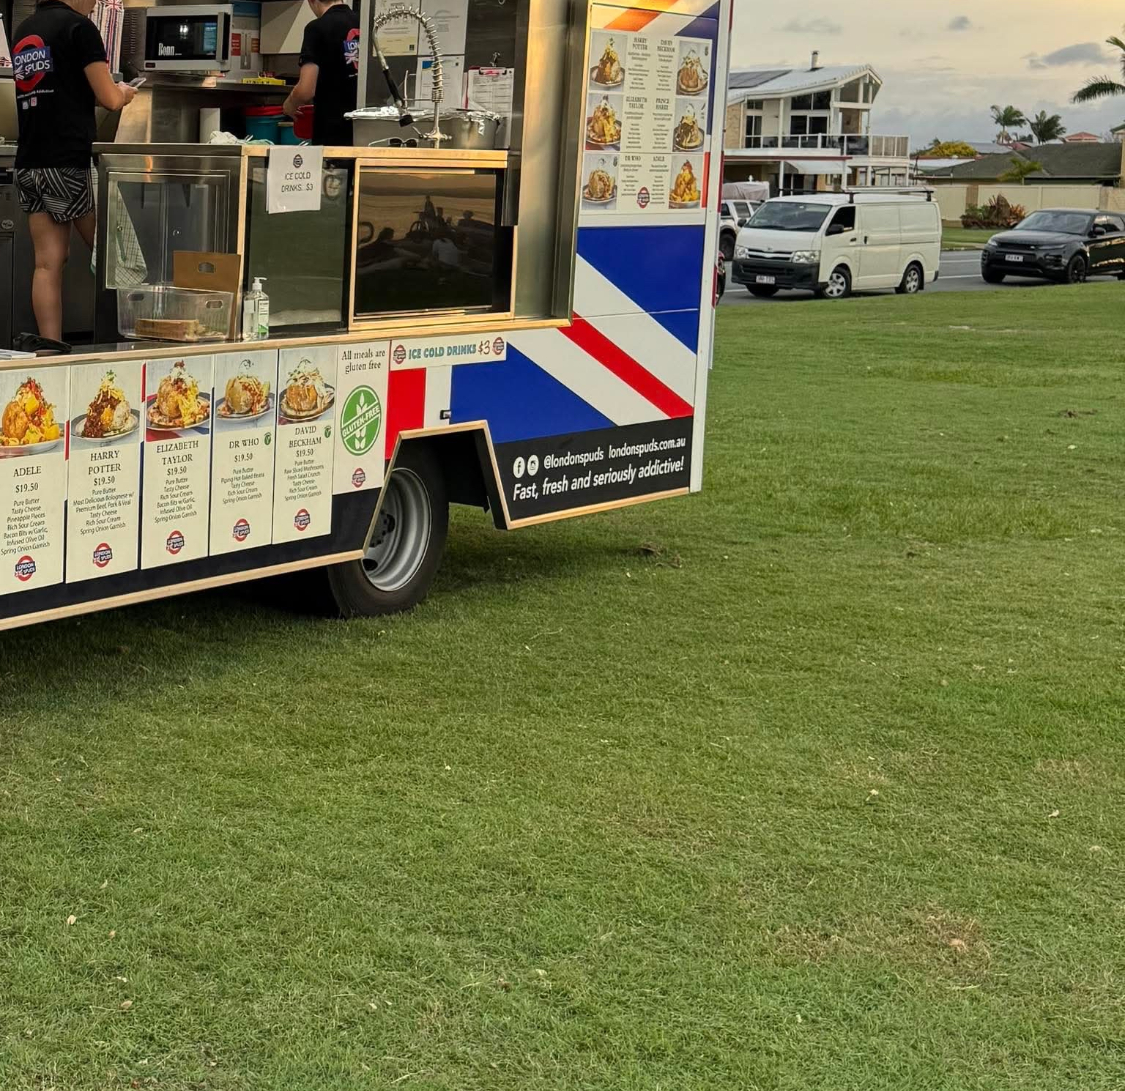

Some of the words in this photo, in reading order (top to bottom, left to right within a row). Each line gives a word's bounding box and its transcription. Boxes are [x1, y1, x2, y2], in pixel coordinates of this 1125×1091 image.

[15, 50, 45, 65] ONDON
[342, 350, 351, 360] All
[354, 349, 374, 359] meals
[409, 349, 421, 359] ICE
[424, 347, 444, 358] COLD
[447, 344, 476, 356] DRINKS
[478, 340, 490, 355] $3
[345, 362, 366, 374] gluten
[369, 361, 381, 370] free
[342, 404, 380, 437] GLUTEN-FREE
[295, 426, 316, 435] DAVID
[157, 440, 199, 453] ELIZABETH
[229, 441, 239, 449] DR
[242, 438, 259, 446] WHO
[289, 437, 322, 448] BECKHAM
[90, 450, 119, 461] HARRY
[234, 453, 253, 462] $19.50
[296, 449, 314, 457] $19.50
[544, 447, 604, 469] @londonspuds
[608, 437, 686, 458] londonspuds.com.au
[162, 454, 193, 465] TAYLOR
[14, 466, 41, 477] ADELE
[88, 463, 121, 475] POTTER
[167, 466, 187, 476] $19.50
[94, 476, 115, 486] $19.50
[513, 483, 538, 501] Fast,
[543, 474, 568, 496] fresh
[571, 471, 591, 490] and
[593, 464, 637, 487] seriously
[638, 456, 684, 478] addictive!
[16, 483, 38, 493] $19.50
[7, 515, 30, 523] Pineapple
[1, 548, 16, 556] Spring
